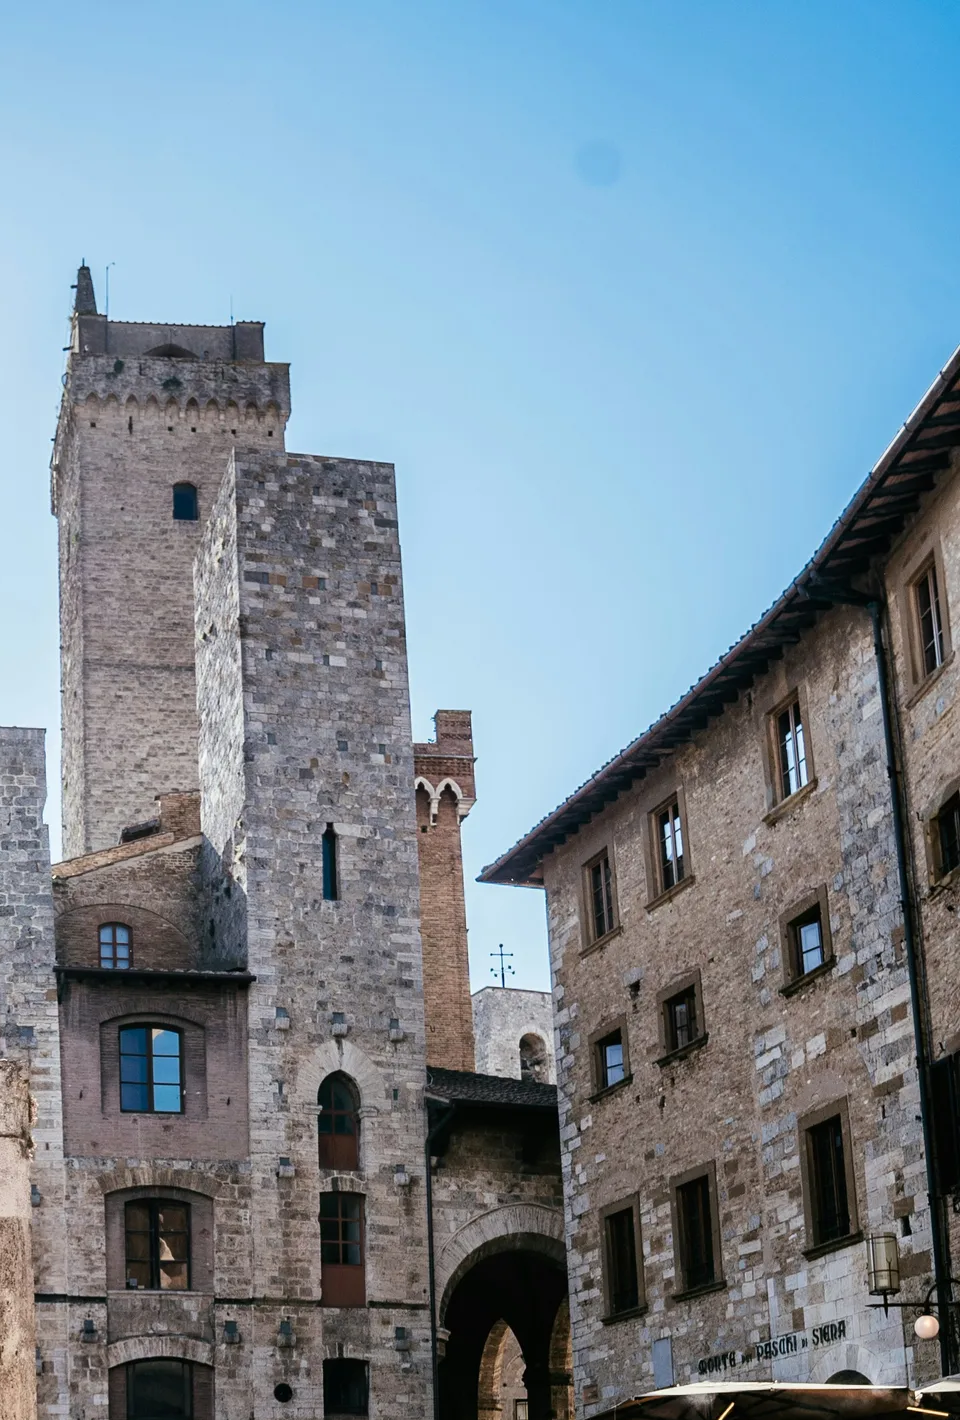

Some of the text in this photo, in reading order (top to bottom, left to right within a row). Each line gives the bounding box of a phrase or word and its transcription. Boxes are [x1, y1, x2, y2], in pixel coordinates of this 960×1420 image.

[698, 1350, 737, 1375] MONTE
[755, 1335, 797, 1361] PASCHI
[801, 1338, 808, 1349] DI
[812, 1320, 846, 1345] SIENA
